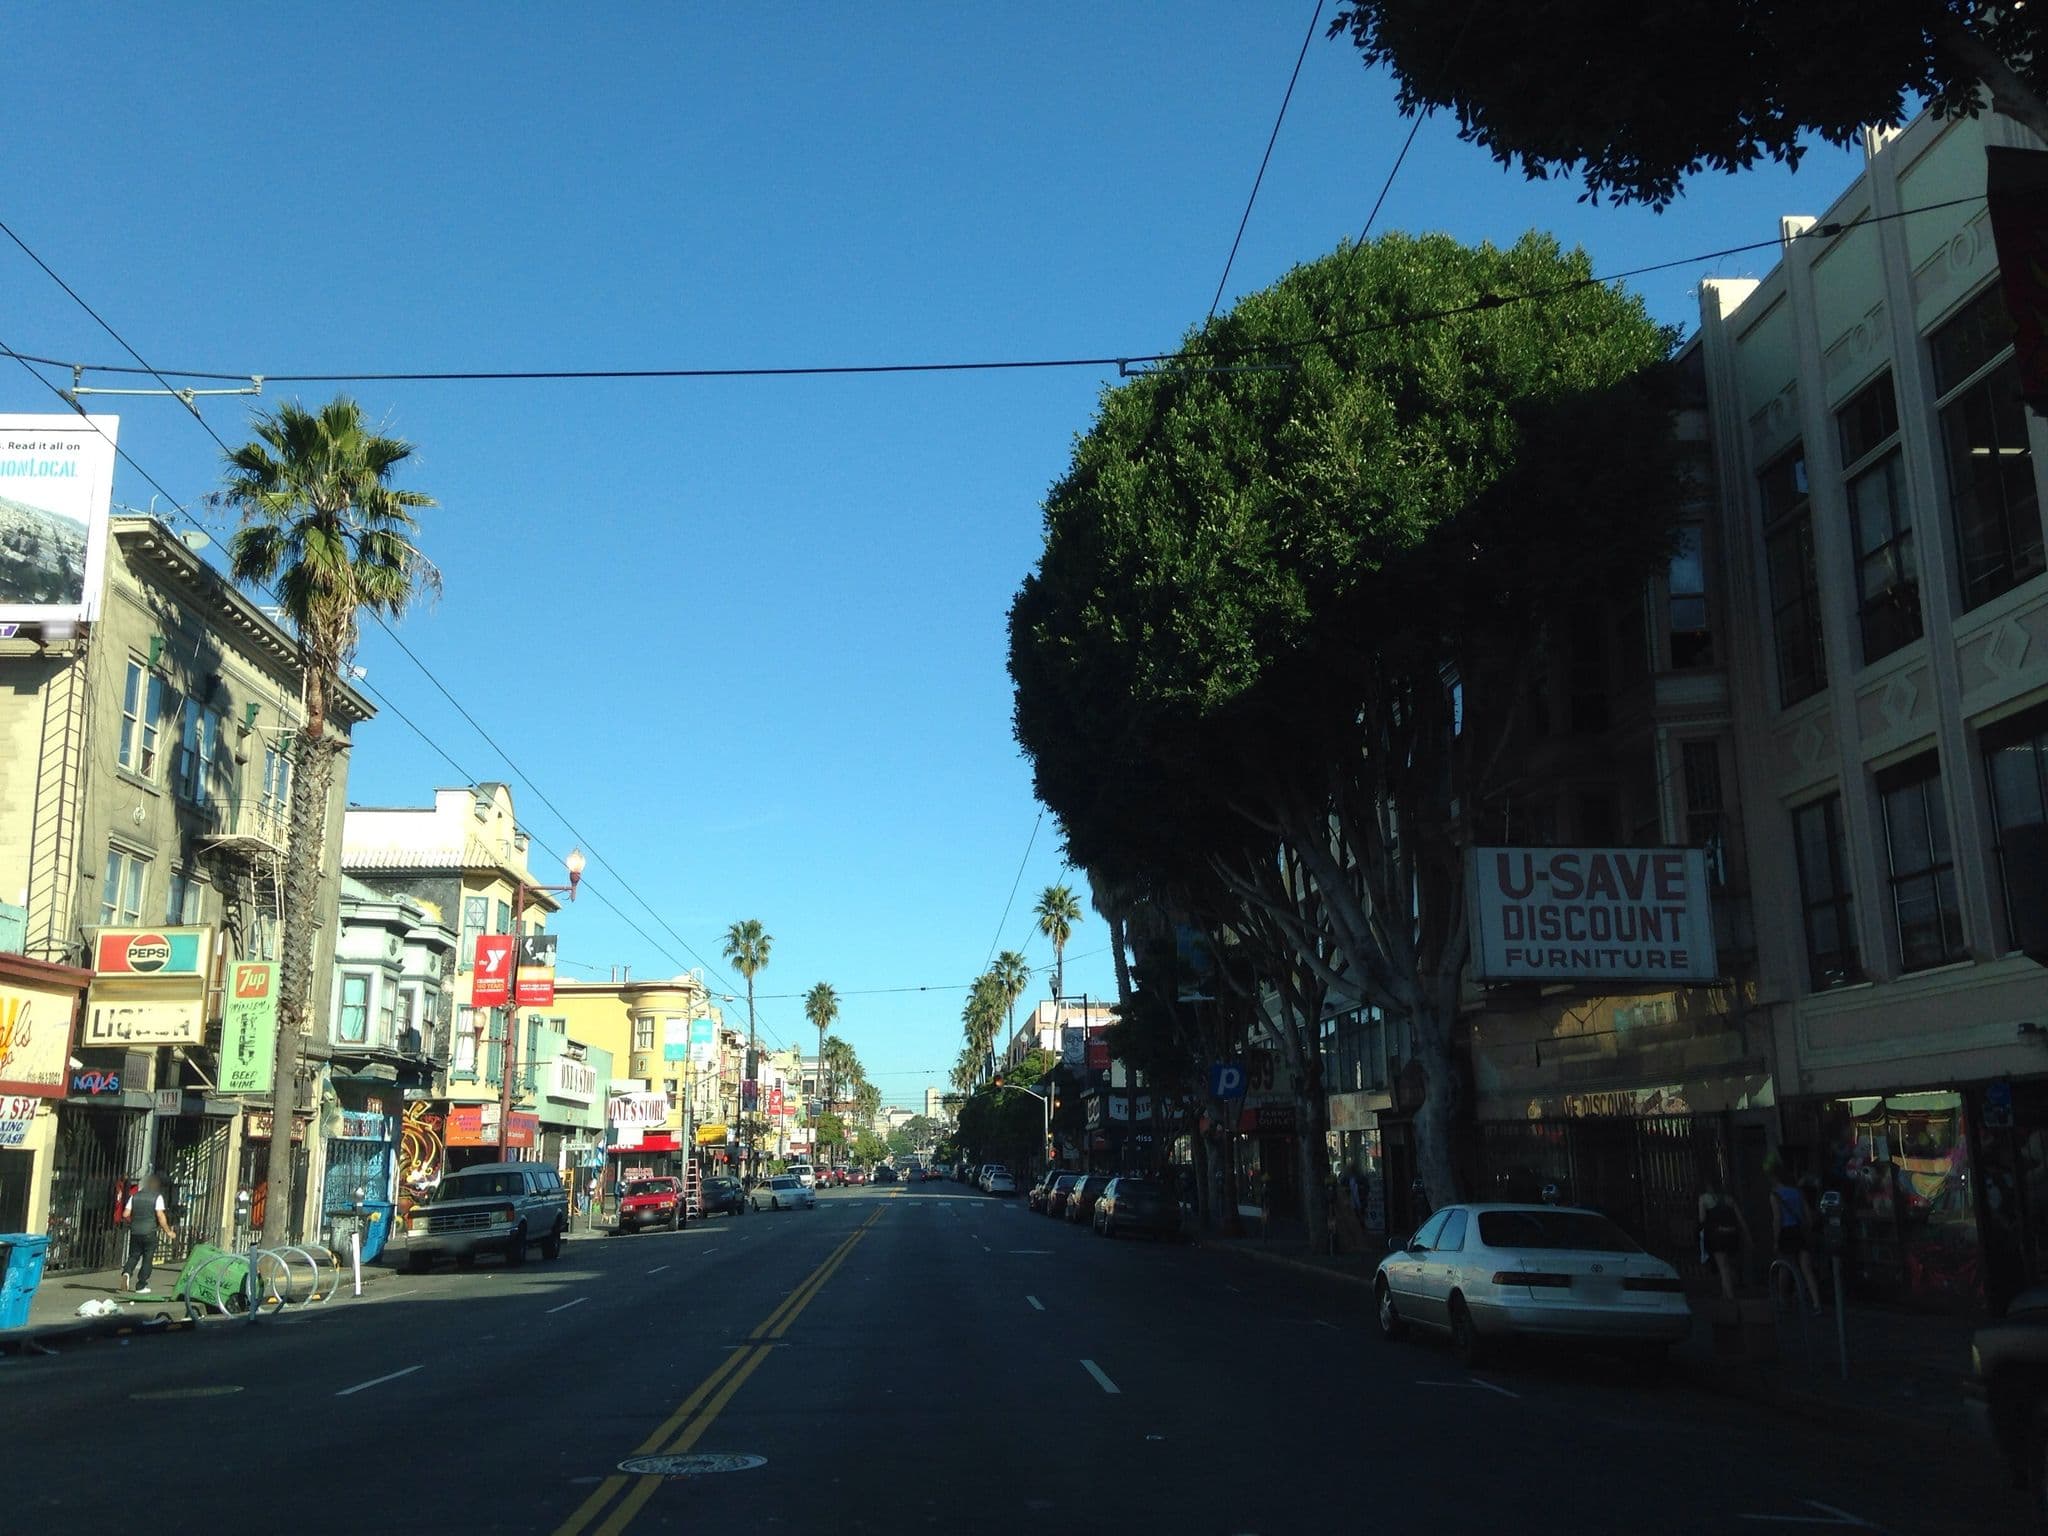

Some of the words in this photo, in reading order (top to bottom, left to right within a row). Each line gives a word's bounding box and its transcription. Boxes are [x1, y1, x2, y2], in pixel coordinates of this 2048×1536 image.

[8, 441, 36, 450] Read
[39, 441, 47, 450] it
[50, 442, 63, 450] all
[1497, 853, 1686, 900] U-SAVE
[1502, 905, 1686, 942] DISCOUNT
[128, 948, 169, 958] PEPSI
[1506, 949, 1688, 969] FURNITURE
[93, 1008, 190, 1039] LIQR
[73, 1076, 119, 1091] NAILS
[229, 1080, 255, 1089] WINE
[10, 1098, 38, 1121] SPA
[639, 1099, 666, 1121] STORE
